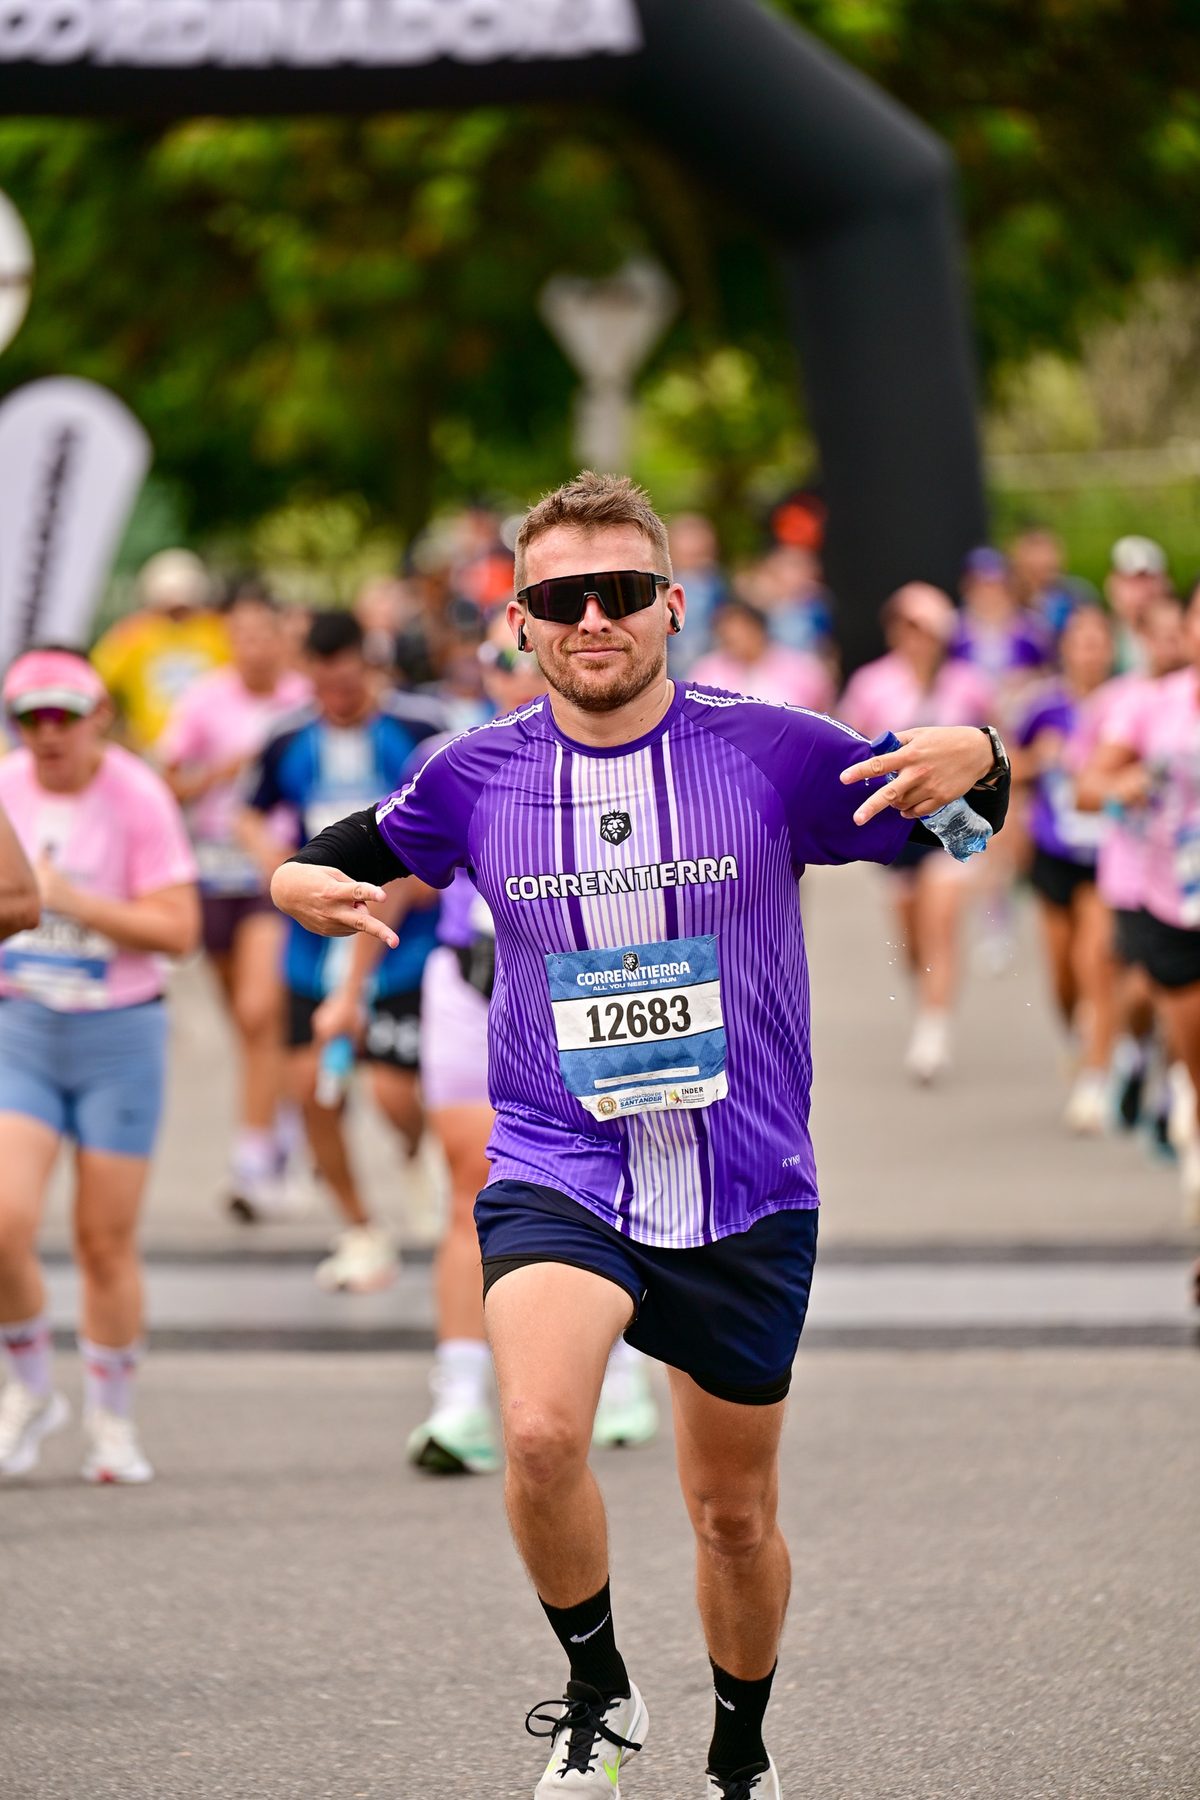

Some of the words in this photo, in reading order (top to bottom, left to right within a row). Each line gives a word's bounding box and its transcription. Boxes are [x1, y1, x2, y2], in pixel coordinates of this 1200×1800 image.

[505, 855, 739, 901] CORREMITIERRA
[576, 961, 691, 986] CORREMITIERRA
[586, 994, 692, 1043] 12683
[620, 1096, 663, 1107] SANTANDER
[681, 1086, 704, 1095] INDER
